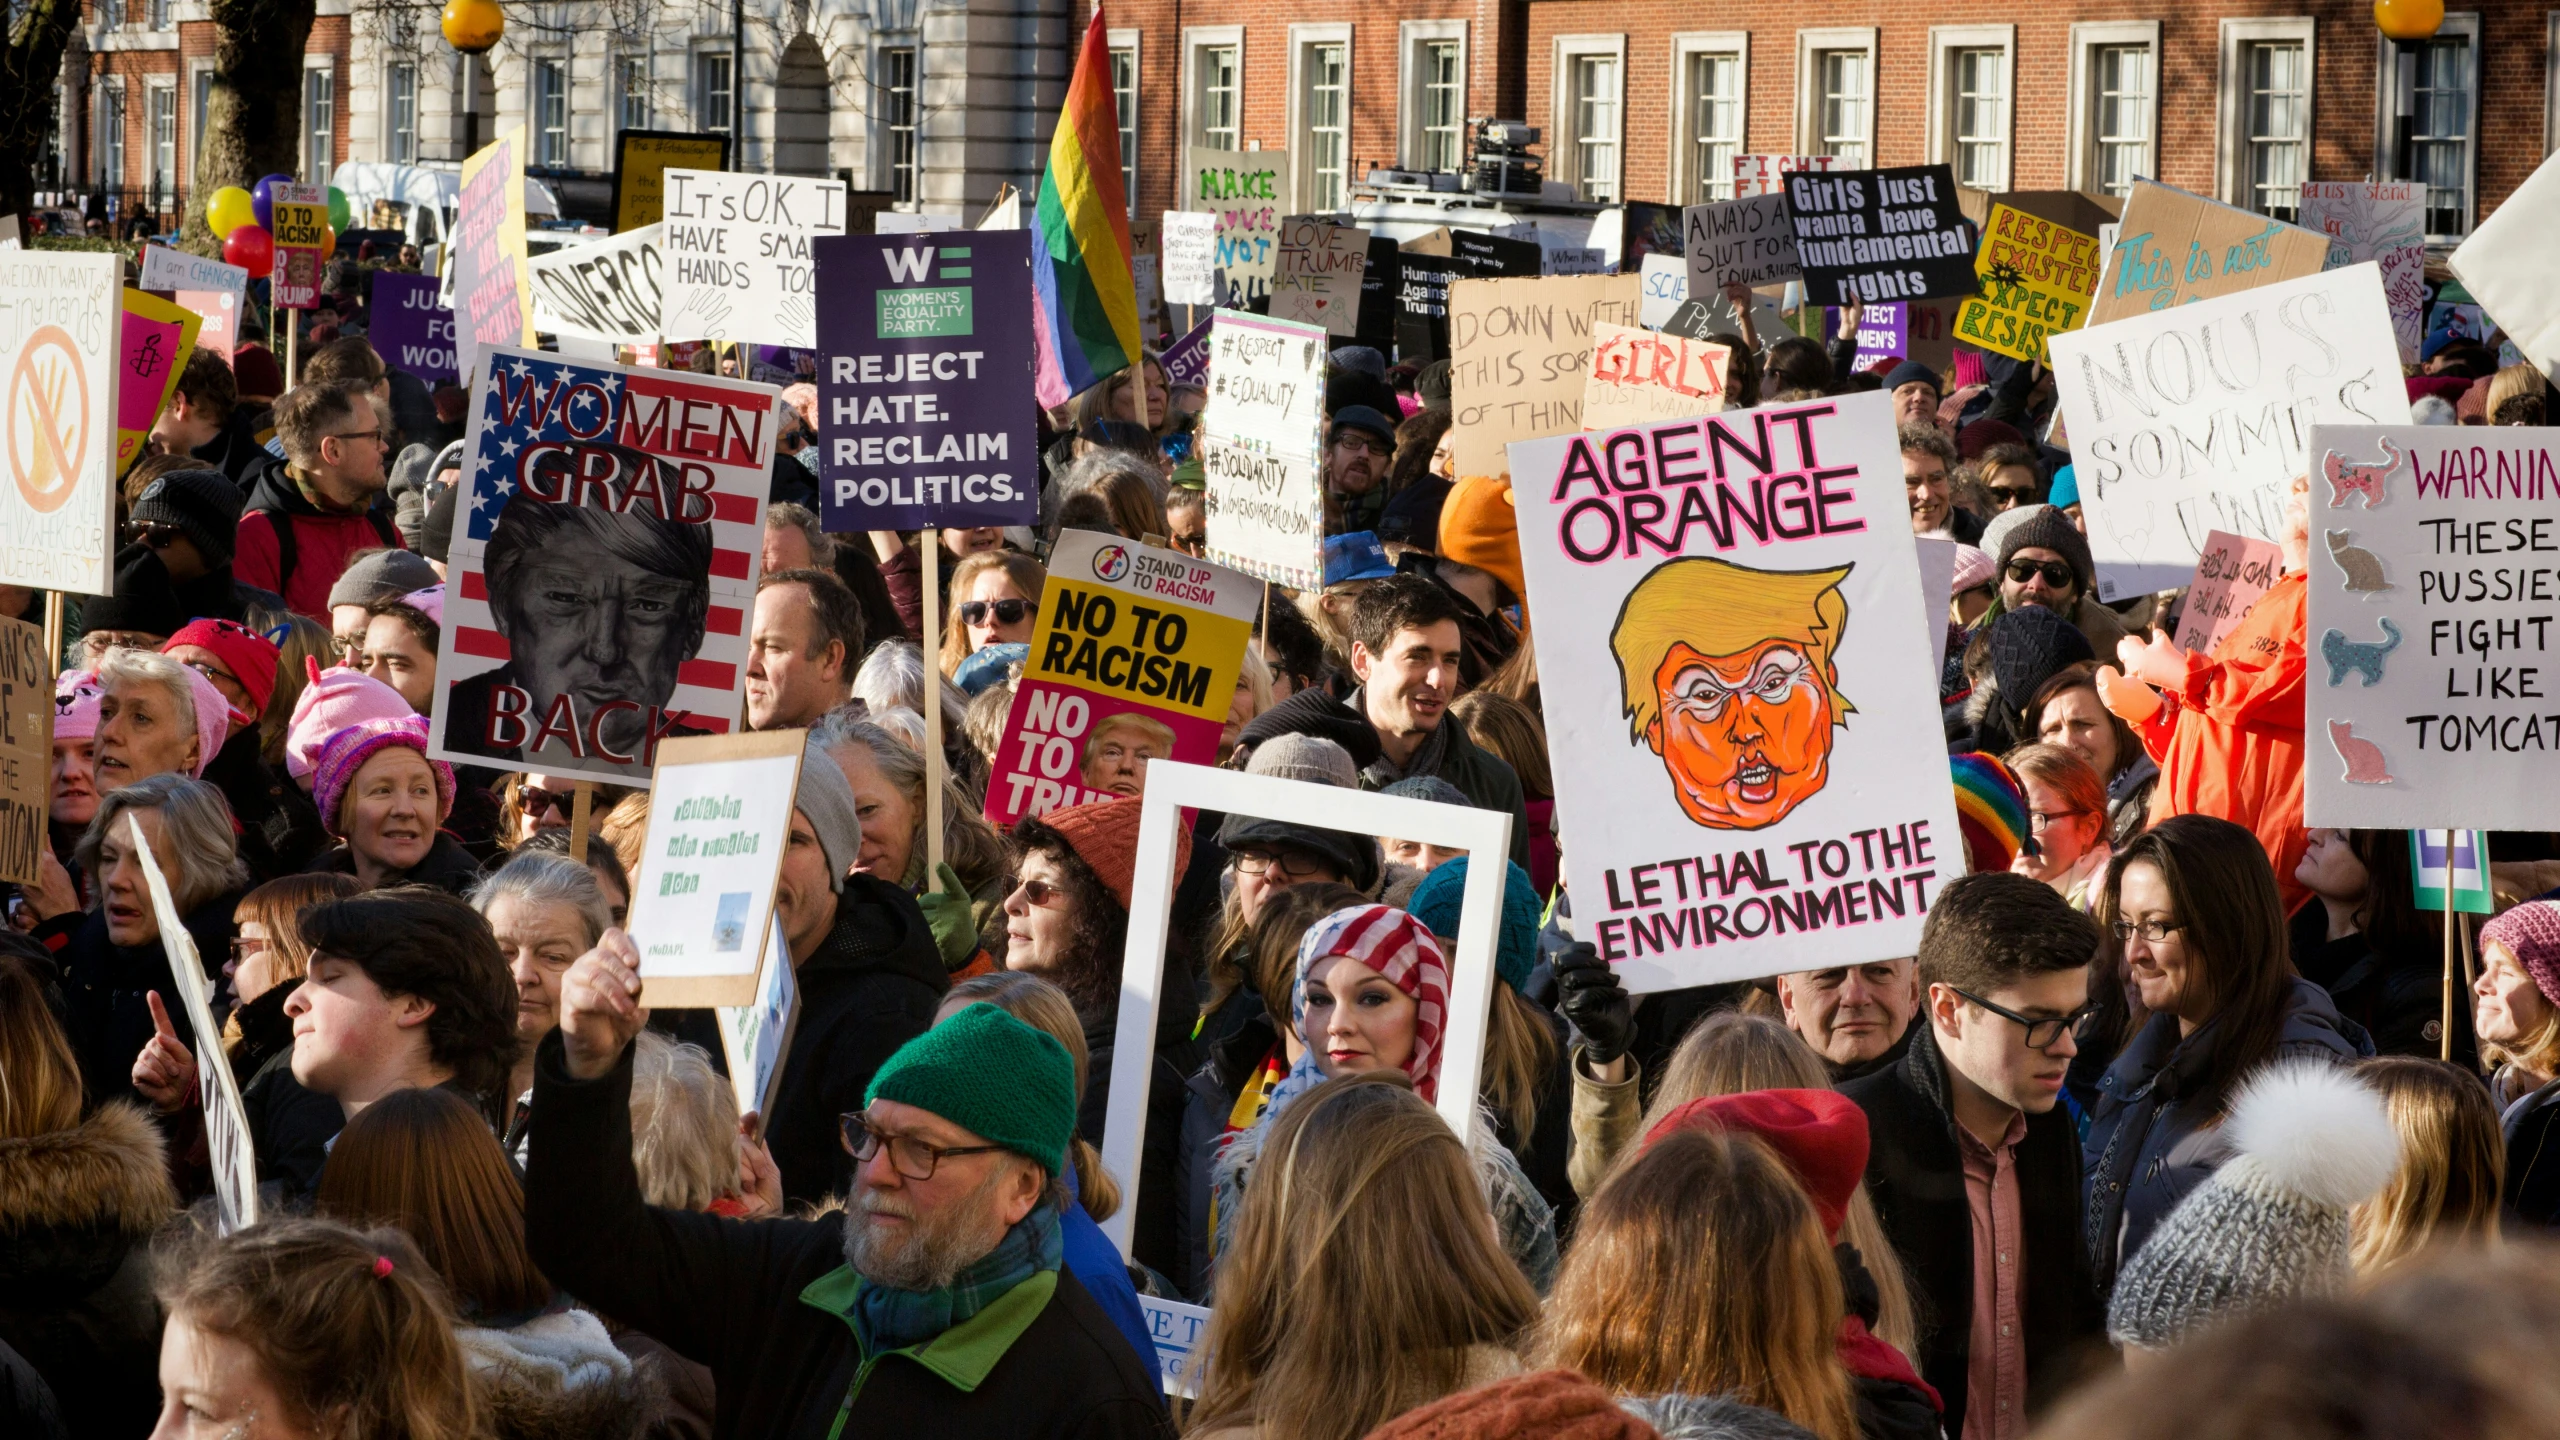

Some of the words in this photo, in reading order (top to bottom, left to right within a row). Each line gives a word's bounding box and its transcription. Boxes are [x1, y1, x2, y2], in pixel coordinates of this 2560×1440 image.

[459, 139, 512, 222] WOMEN'S
[1200, 166, 1277, 201] MAKE
[1792, 176, 1866, 212] Girls
[1876, 175, 1938, 207] just
[2301, 182, 2320, 199] let
[2325, 184, 2345, 199] us
[2363, 182, 2411, 200] stand
[293, 207, 313, 226] TO
[466, 188, 506, 253] RIGHTS
[813, 185, 843, 230] I
[1771, 198, 1786, 227] A
[1794, 213, 1867, 237] wanna
[1878, 207, 1938, 234] have
[669, 225, 728, 254] HAVE
[1281, 223, 1354, 249] LOVE
[2323, 215, 2343, 237] for
[478, 234, 500, 280] ARE
[1168, 250, 1190, 259] HAVE
[1213, 234, 1271, 269] NOT
[1551, 250, 1580, 264] When
[1697, 240, 1746, 274] SLUT
[1754, 235, 1794, 260] FOR
[1796, 225, 1969, 268] fundamental
[2114, 232, 2174, 299] This
[2185, 241, 2213, 283] is
[2223, 221, 2285, 276] not
[166, 262, 185, 277] am
[190, 262, 246, 292] CHANGING
[677, 258, 751, 289] HANDS
[1402, 265, 1466, 284] Humanity
[1494, 260, 1505, 269] by
[1717, 267, 1765, 290] EQUAL
[1766, 261, 1801, 280] RIGHTS
[22, 258, 56, 288] DON'T
[59, 266, 97, 289] WANT
[89, 267, 113, 311] YOUR
[468, 254, 518, 324] HUMAN
[882, 291, 960, 305] WOMEN'S
[1274, 272, 1334, 293] HATE
[1837, 270, 1928, 304] rights
[882, 304, 965, 321] EQUALITY
[1402, 298, 1446, 318] Trump
[1974, 273, 2080, 329] EXPECT
[49, 295, 103, 357] hands
[475, 295, 523, 345] RIGHTS
[882, 319, 941, 334] PARTY.
[1456, 303, 1553, 351] DOWN
[1566, 300, 1636, 337] WITH
[678, 343, 694, 352] THE
[2076, 290, 2340, 424] NOUS
[831, 351, 984, 384] REJECT
[1456, 350, 1525, 389] THIS
[1593, 333, 1729, 401] GIRLS
[497, 369, 762, 465] WOMEN
[832, 394, 950, 425] HATE.
[1457, 402, 1495, 427] OF
[1591, 382, 1645, 406] JUST
[1650, 398, 1712, 419] WANNA
[833, 432, 1009, 466] RECLAIM
[1551, 401, 1838, 504] AGENT
[516, 440, 717, 526] GRAB
[834, 473, 1025, 508] POLITICS.
[0, 473, 74, 550] ANYWHERE
[75, 460, 104, 527] NEAR
[1558, 464, 1868, 566] ORANGE
[73, 524, 103, 554] OUR
[2418, 518, 2559, 555] THESE
[1135, 554, 1186, 580] STAND
[1187, 567, 1212, 585] UP
[1132, 571, 1153, 590] TO
[1155, 579, 1216, 606] RACISM
[1052, 588, 1117, 638] NO
[1130, 605, 1188, 656] TO
[2430, 616, 2553, 664] FIGHT
[1041, 631, 1213, 708] RACISM
[2447, 667, 2544, 700] LIKE
[484, 683, 692, 769] BACK
[1023, 688, 1090, 739] NO
[1017, 732, 1075, 780] TO
[1604, 847, 1790, 915] LETHAL
[1787, 837, 1851, 887] TO
[1850, 819, 1937, 875] THE
[1594, 868, 1937, 965] ENVIRONMENT
[647, 943, 685, 957] #NoDAPL
